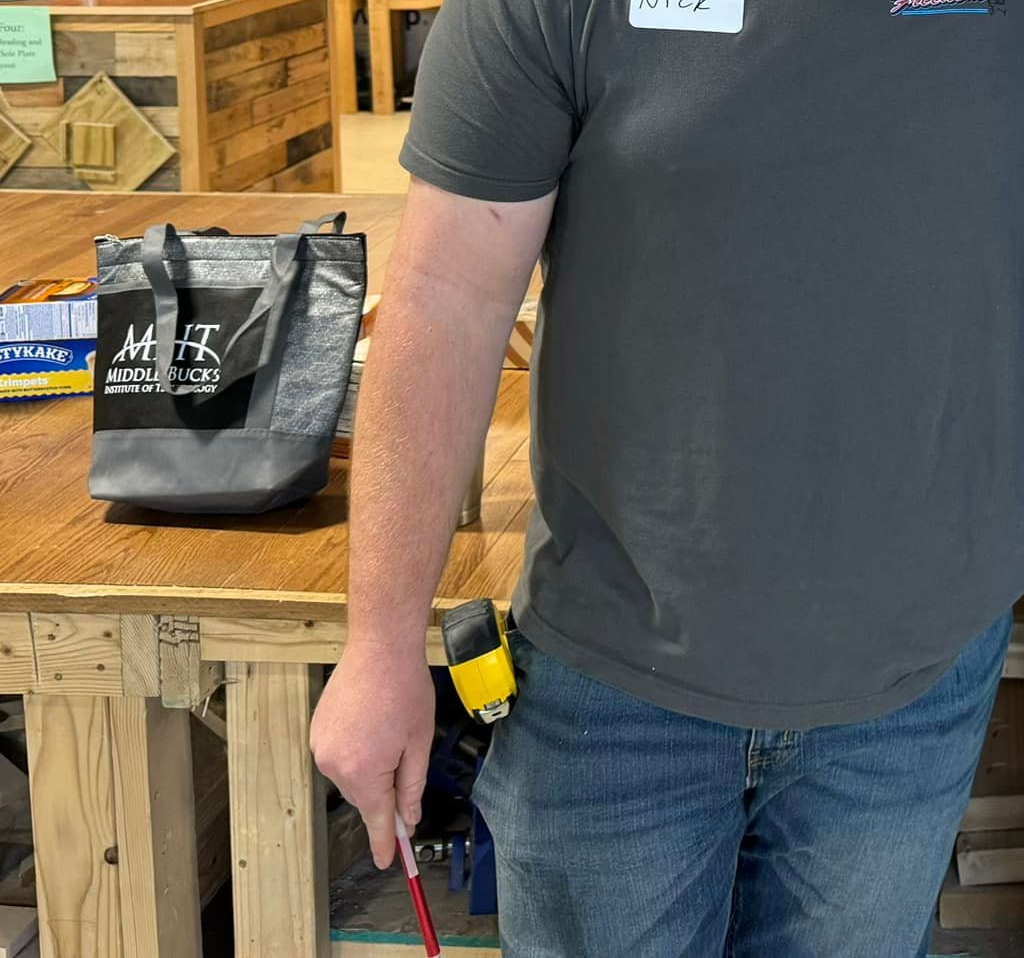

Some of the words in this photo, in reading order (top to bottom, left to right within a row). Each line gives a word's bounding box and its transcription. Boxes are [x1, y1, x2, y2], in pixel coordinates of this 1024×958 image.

[118, 323, 221, 362] MIT
[0, 345, 70, 363] TYKAKE
[167, 366, 221, 382] BUCKS
[104, 384, 140, 395] INSTITUTE
[141, 384, 154, 393] OF
